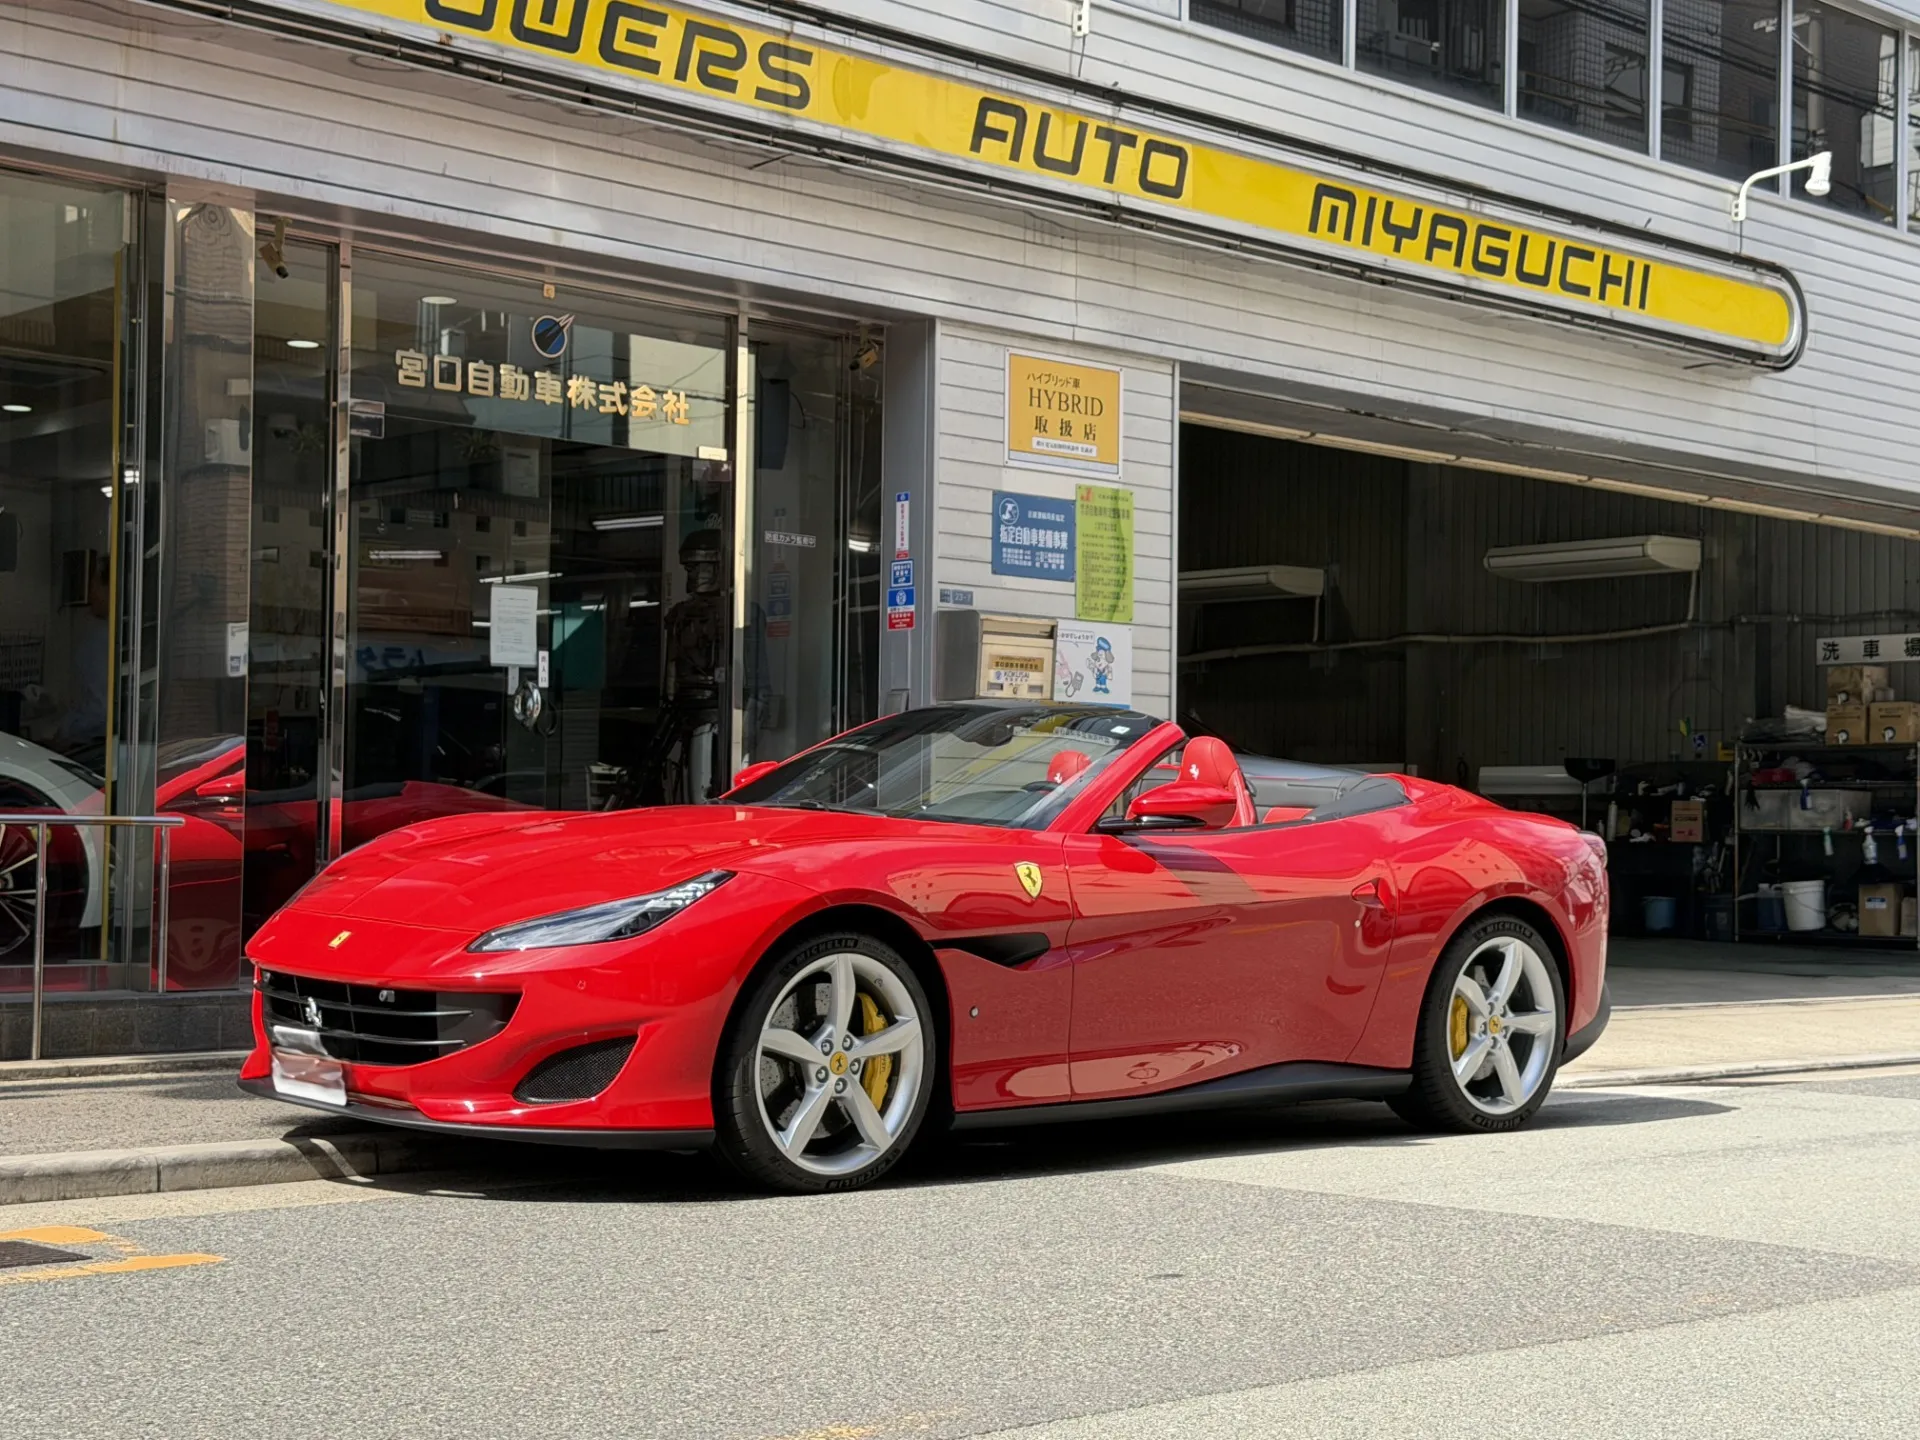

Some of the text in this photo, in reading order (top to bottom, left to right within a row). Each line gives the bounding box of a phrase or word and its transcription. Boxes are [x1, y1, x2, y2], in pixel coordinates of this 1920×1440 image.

[969, 96, 1189, 200] AUTO
[1308, 182, 1651, 310] MIYAGUCHI
[396, 348, 690, 426] 宮口自動車株式会社
[1027, 372, 1081, 389] ハイブリッド車
[1028, 387, 1104, 417] HYBRID
[1034, 415, 1097, 441] 取扱店
[1000, 524, 1068, 550] 指定自動車整備事業
[1822, 637, 1920, 661] 洗車場
[1487, 922, 1532, 938] MICHELIN
[796, 939, 858, 964] MICHELIN
